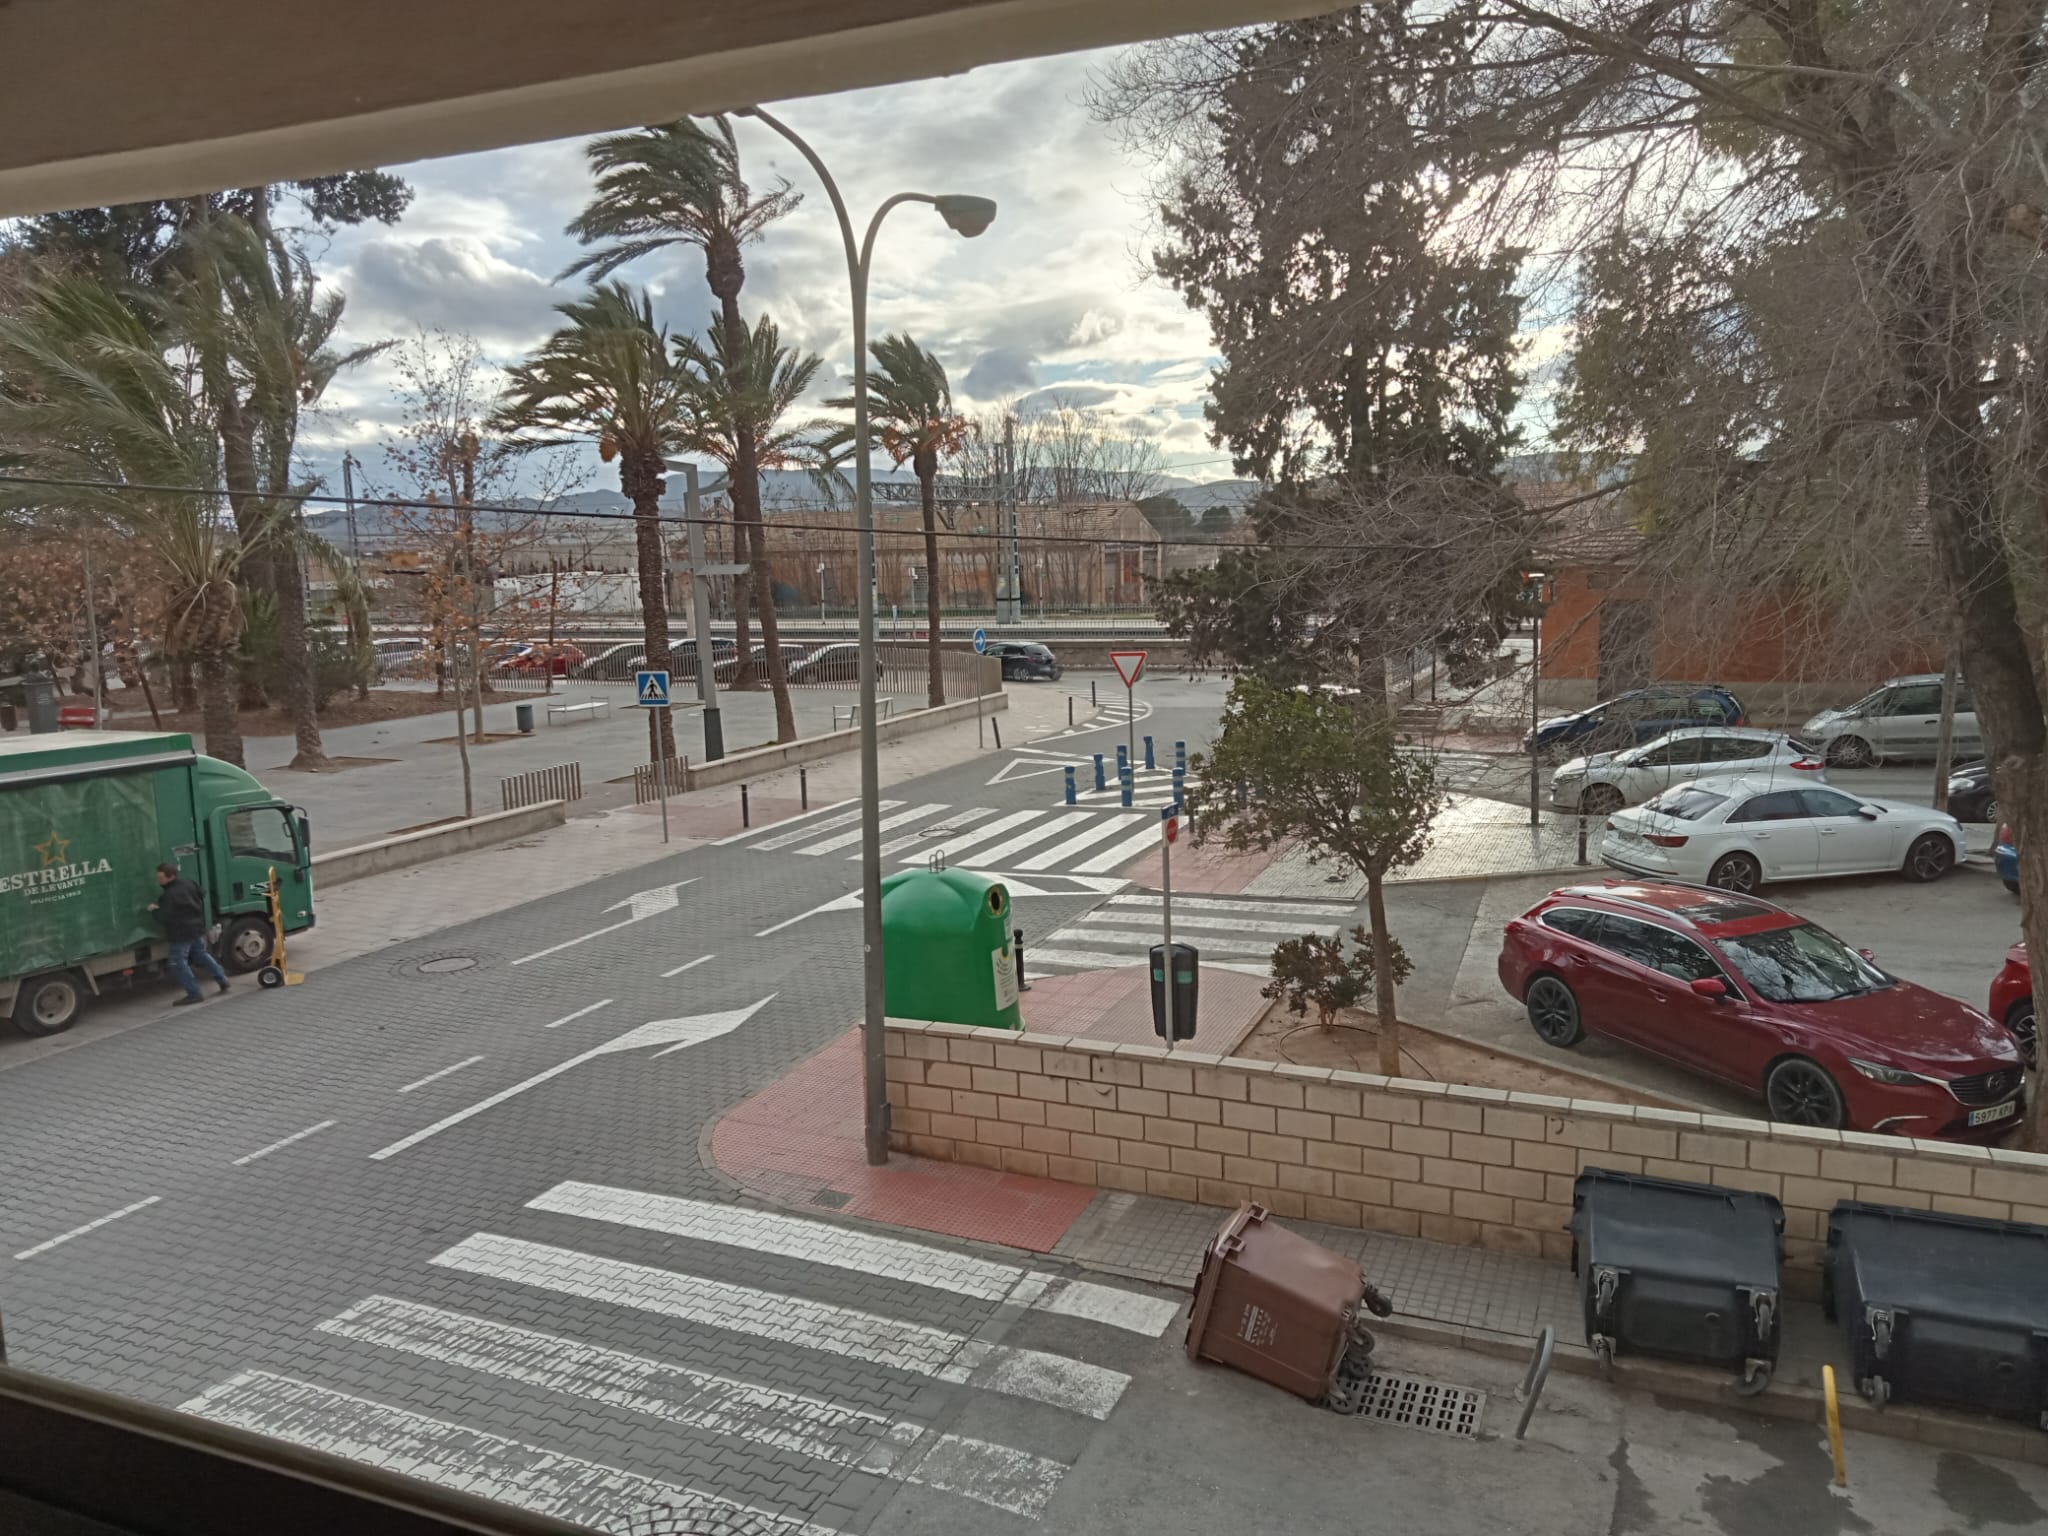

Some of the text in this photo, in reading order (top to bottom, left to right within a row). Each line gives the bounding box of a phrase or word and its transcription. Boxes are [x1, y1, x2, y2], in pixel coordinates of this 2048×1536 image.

[0, 858, 112, 892] ESTRELLA
[24, 877, 85, 896] DE LEVANTE
[1975, 1109, 1996, 1123] 5977
